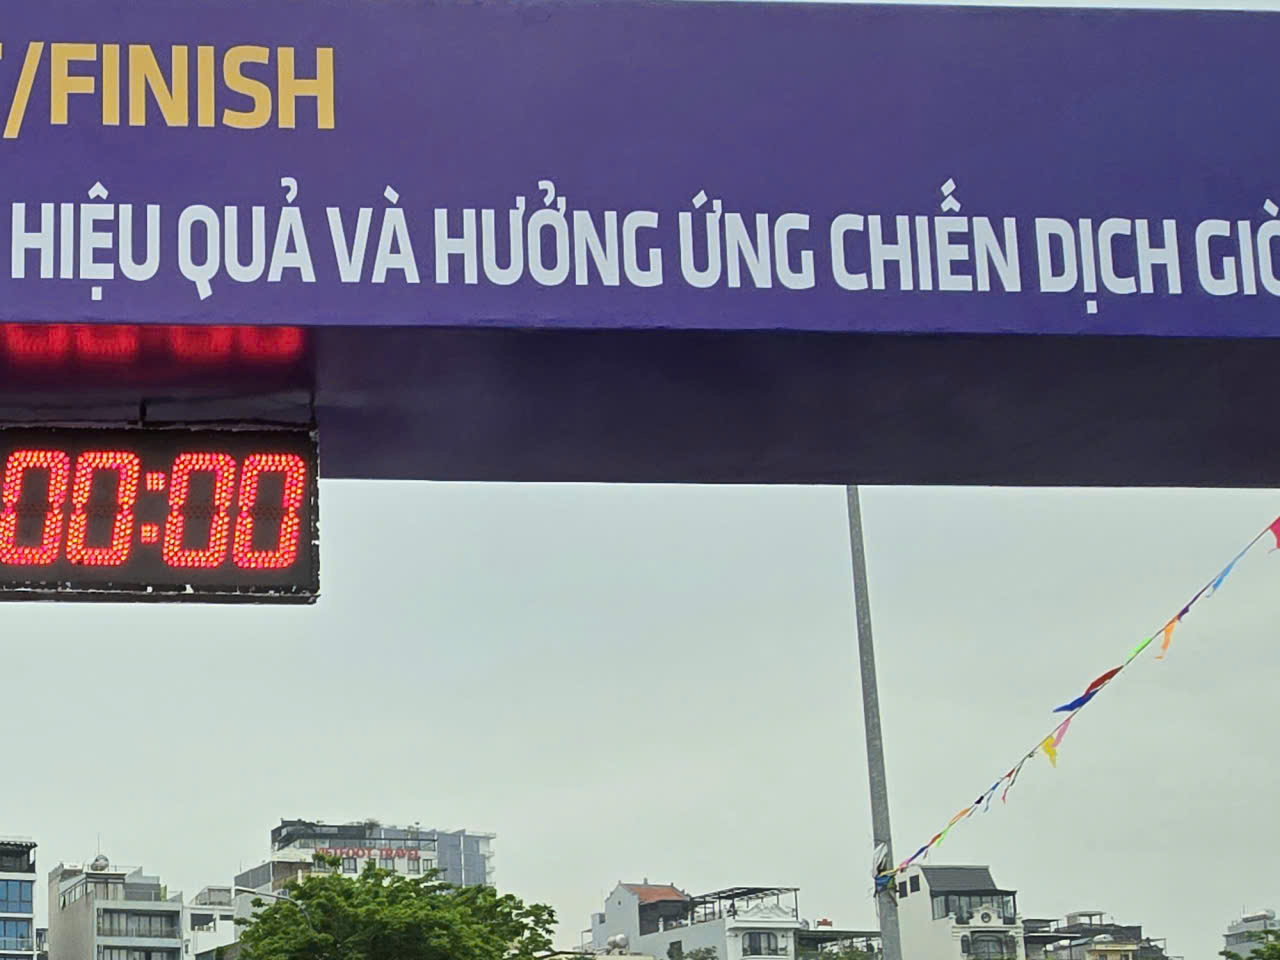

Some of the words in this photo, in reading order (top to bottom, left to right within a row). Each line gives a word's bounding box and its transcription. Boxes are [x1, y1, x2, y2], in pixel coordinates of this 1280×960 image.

[12, 181, 161, 301] HIỆU
[178, 177, 317, 301] QUẢ
[326, 185, 420, 284] VÀ
[434, 180, 663, 287] HƯỞNG
[679, 189, 815, 290] ỨNG
[831, 179, 1022, 293] CHIẾN
[1035, 217, 1183, 314] DỊCH
